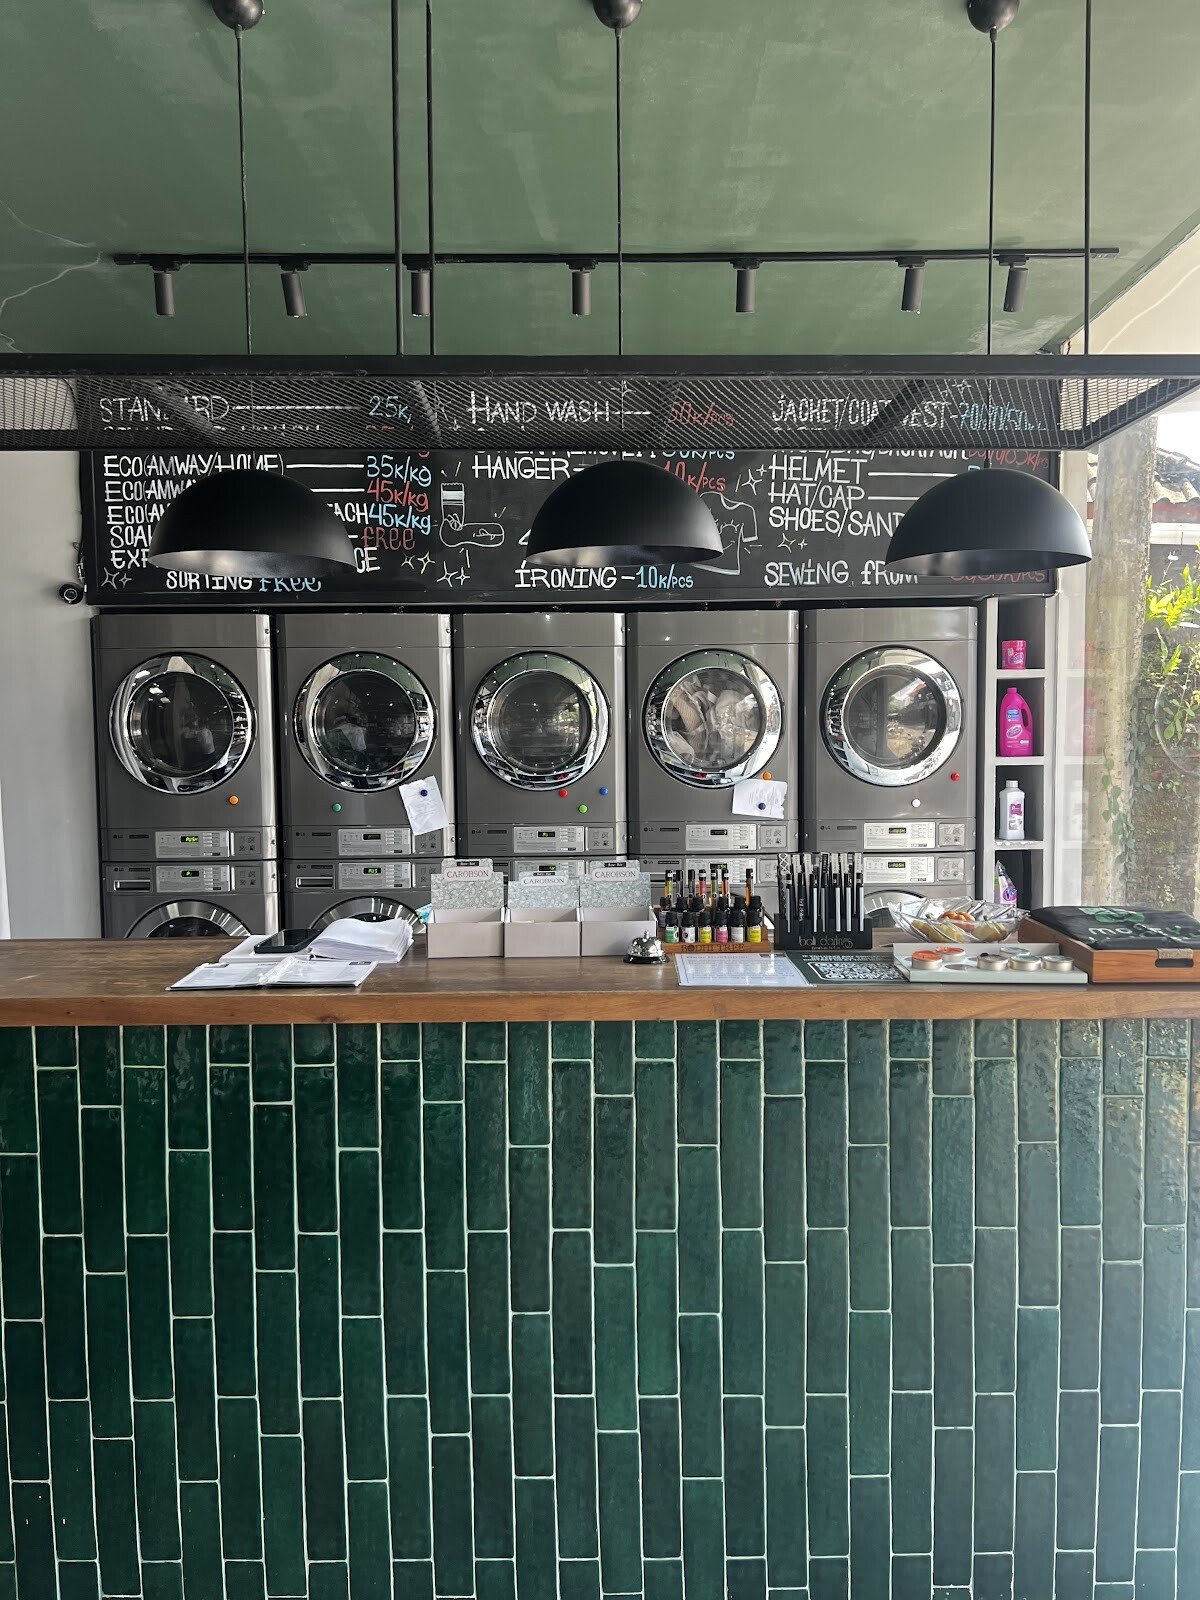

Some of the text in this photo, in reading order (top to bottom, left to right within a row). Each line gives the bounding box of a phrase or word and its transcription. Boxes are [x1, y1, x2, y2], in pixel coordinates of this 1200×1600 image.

[99, 395, 230, 422] STANRD
[467, 391, 610, 424] HAND WASH
[472, 455, 571, 480] HANGER
[768, 454, 868, 484] HELMET
[768, 480, 865, 509] HAT/CAP
[446, 870, 489, 879] CAROBSON
[523, 877, 565, 885] CAROBSON
[594, 870, 637, 879] CAROBSON
[717, 943, 745, 952] TREE
